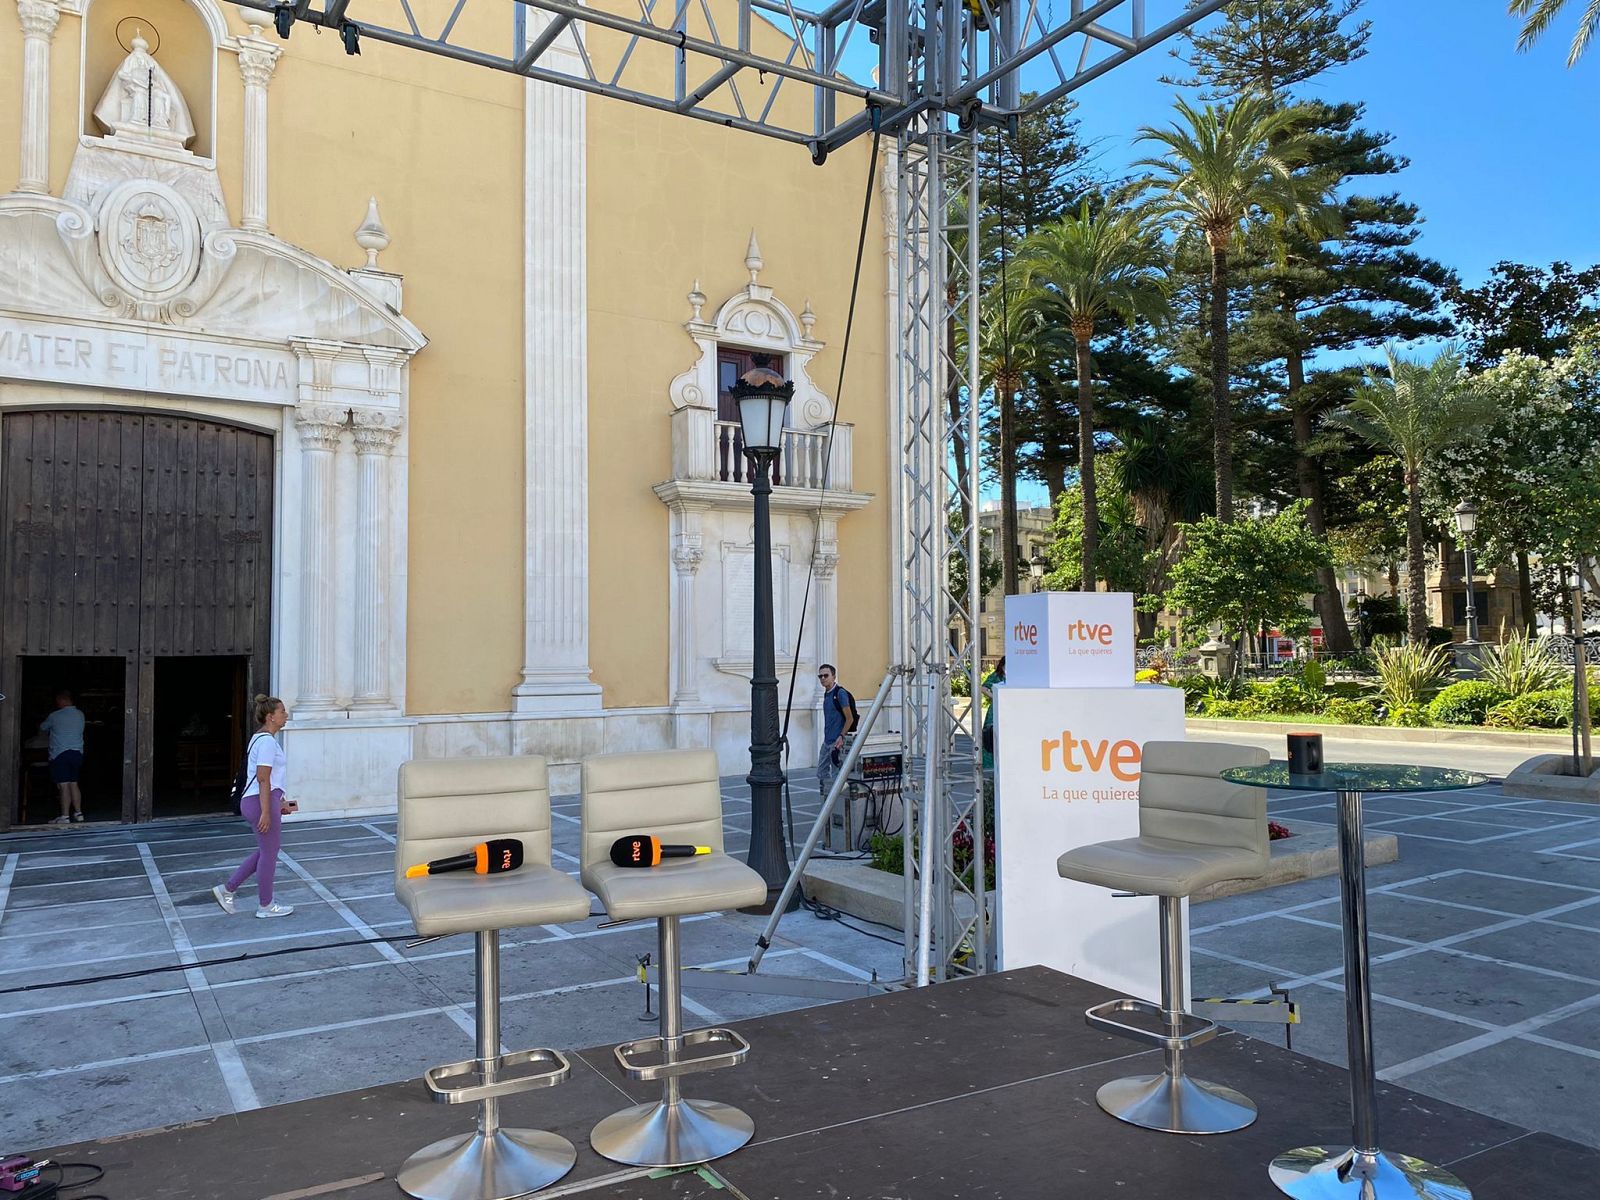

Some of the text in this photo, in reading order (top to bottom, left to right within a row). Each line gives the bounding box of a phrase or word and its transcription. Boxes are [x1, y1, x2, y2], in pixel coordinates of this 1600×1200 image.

[107, 342, 145, 374] ET
[159, 348, 288, 389] PATRONA
[1014, 620, 1037, 646] rtve
[1068, 619, 1113, 645] rtve
[1041, 730, 1142, 782] rtve
[1042, 786, 1058, 800] La
[1063, 789, 1088, 803] que
[502, 849, 512, 869] rtve
[632, 841, 641, 861] rtve
